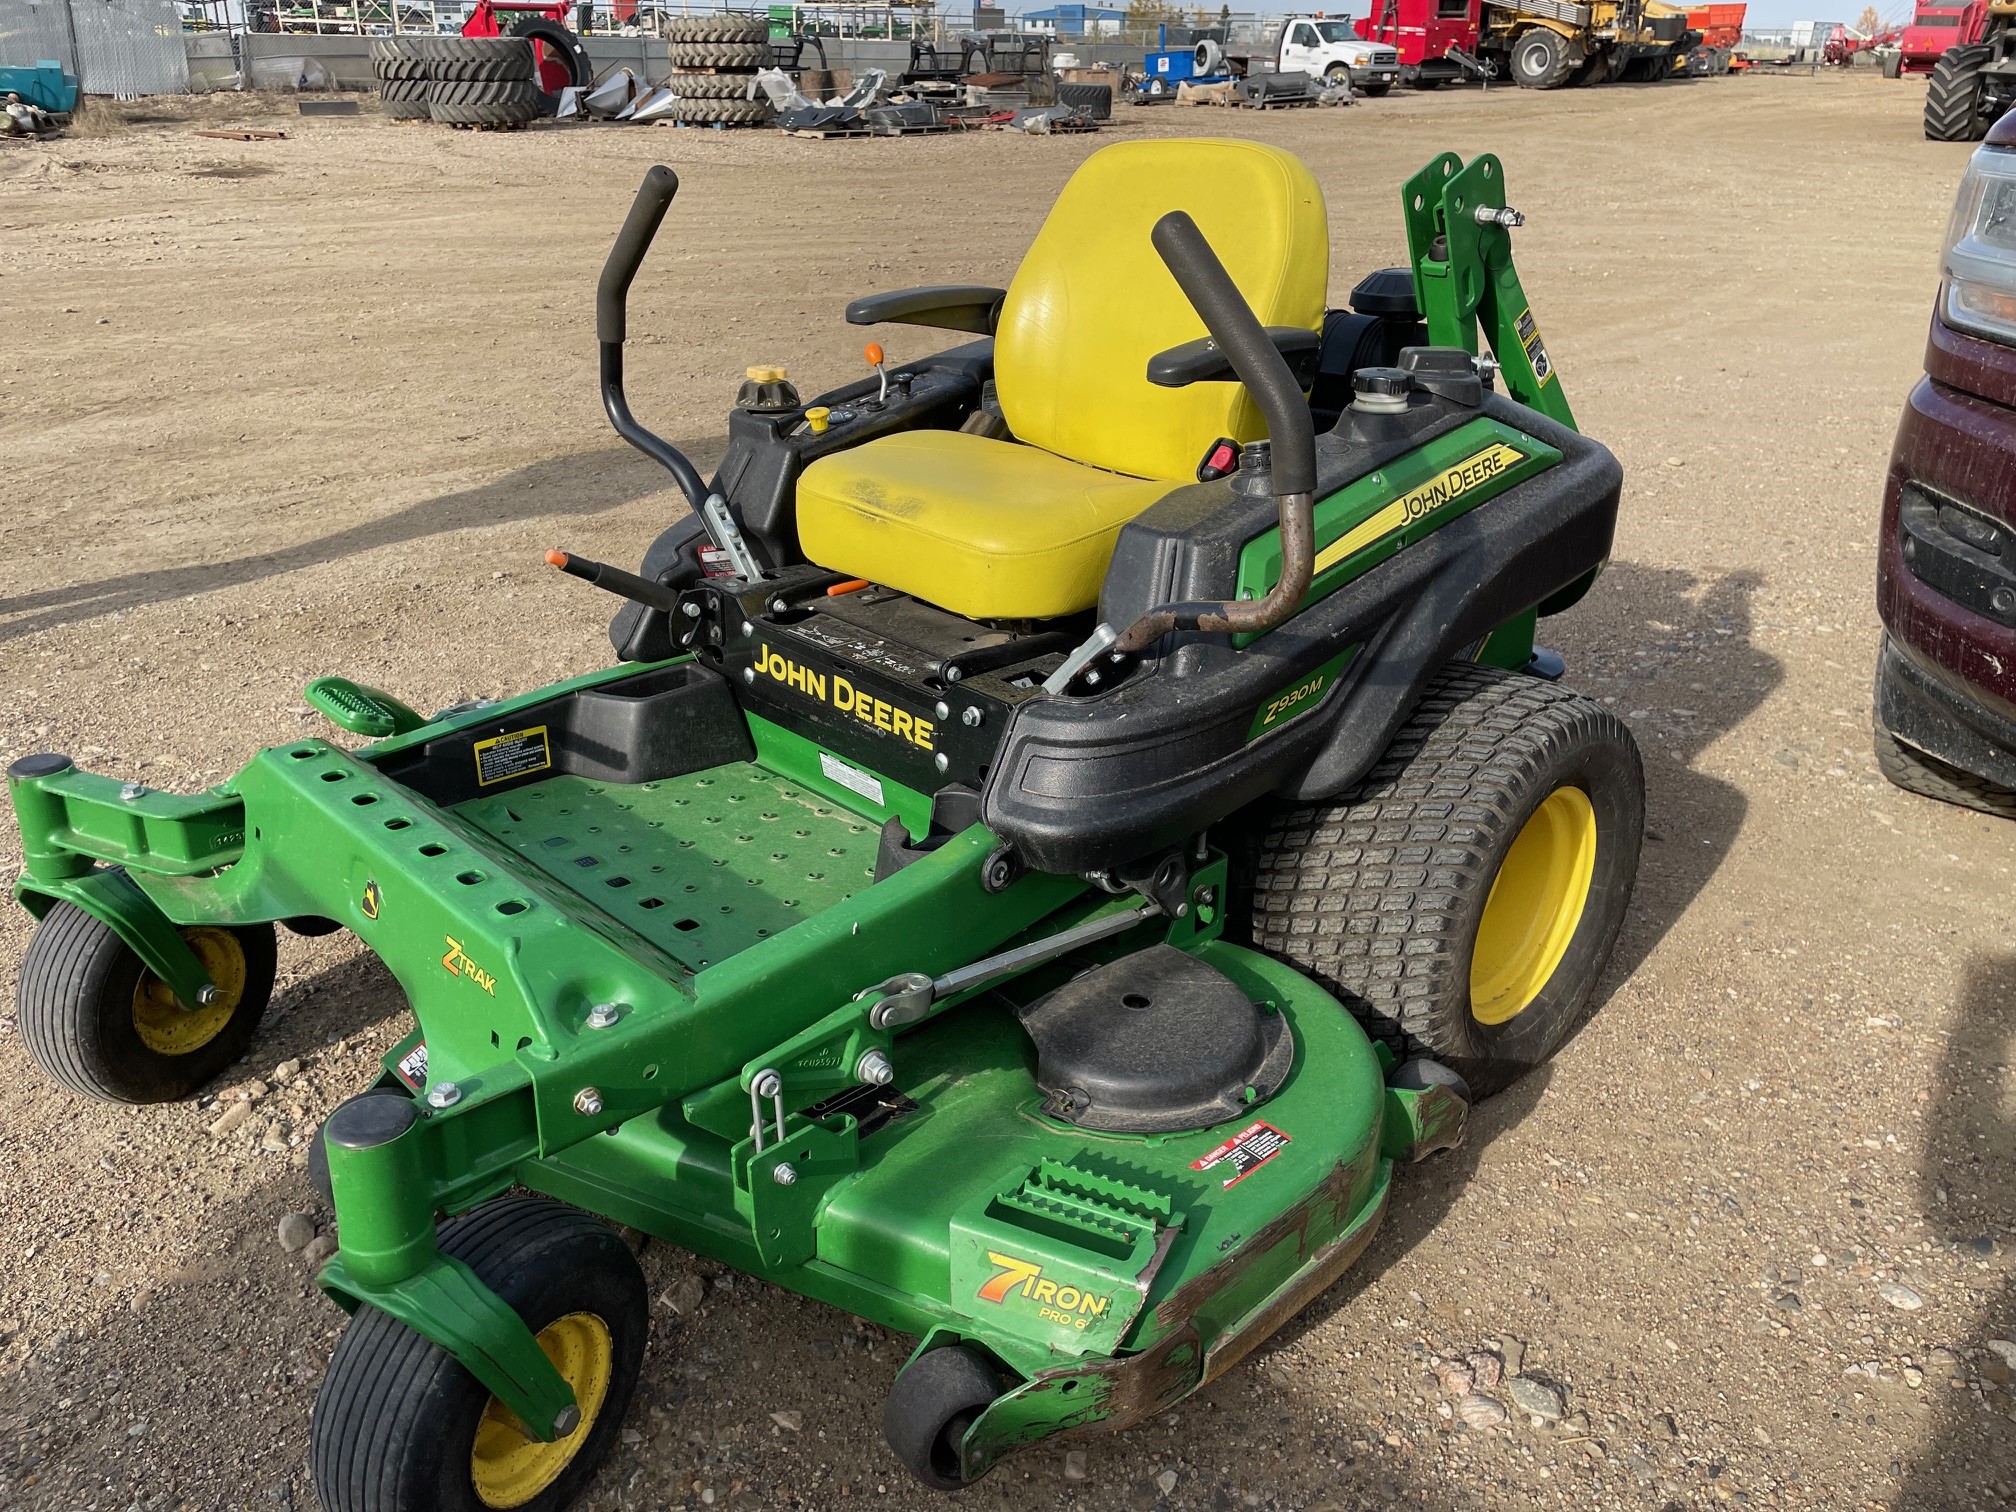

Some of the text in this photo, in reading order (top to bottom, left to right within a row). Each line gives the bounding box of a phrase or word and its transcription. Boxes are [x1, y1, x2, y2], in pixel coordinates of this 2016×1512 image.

[1401, 451, 1504, 524] JOHN DEERE
[754, 643, 934, 750] JOHN DEERE
[1263, 675, 1324, 725] Z930M
[500, 732, 523, 743] CAUTION
[1204, 1145, 1229, 1162] DANGER
[1237, 1123, 1262, 1140] PELIGRO
[1038, 1307, 1072, 1326] PRO
